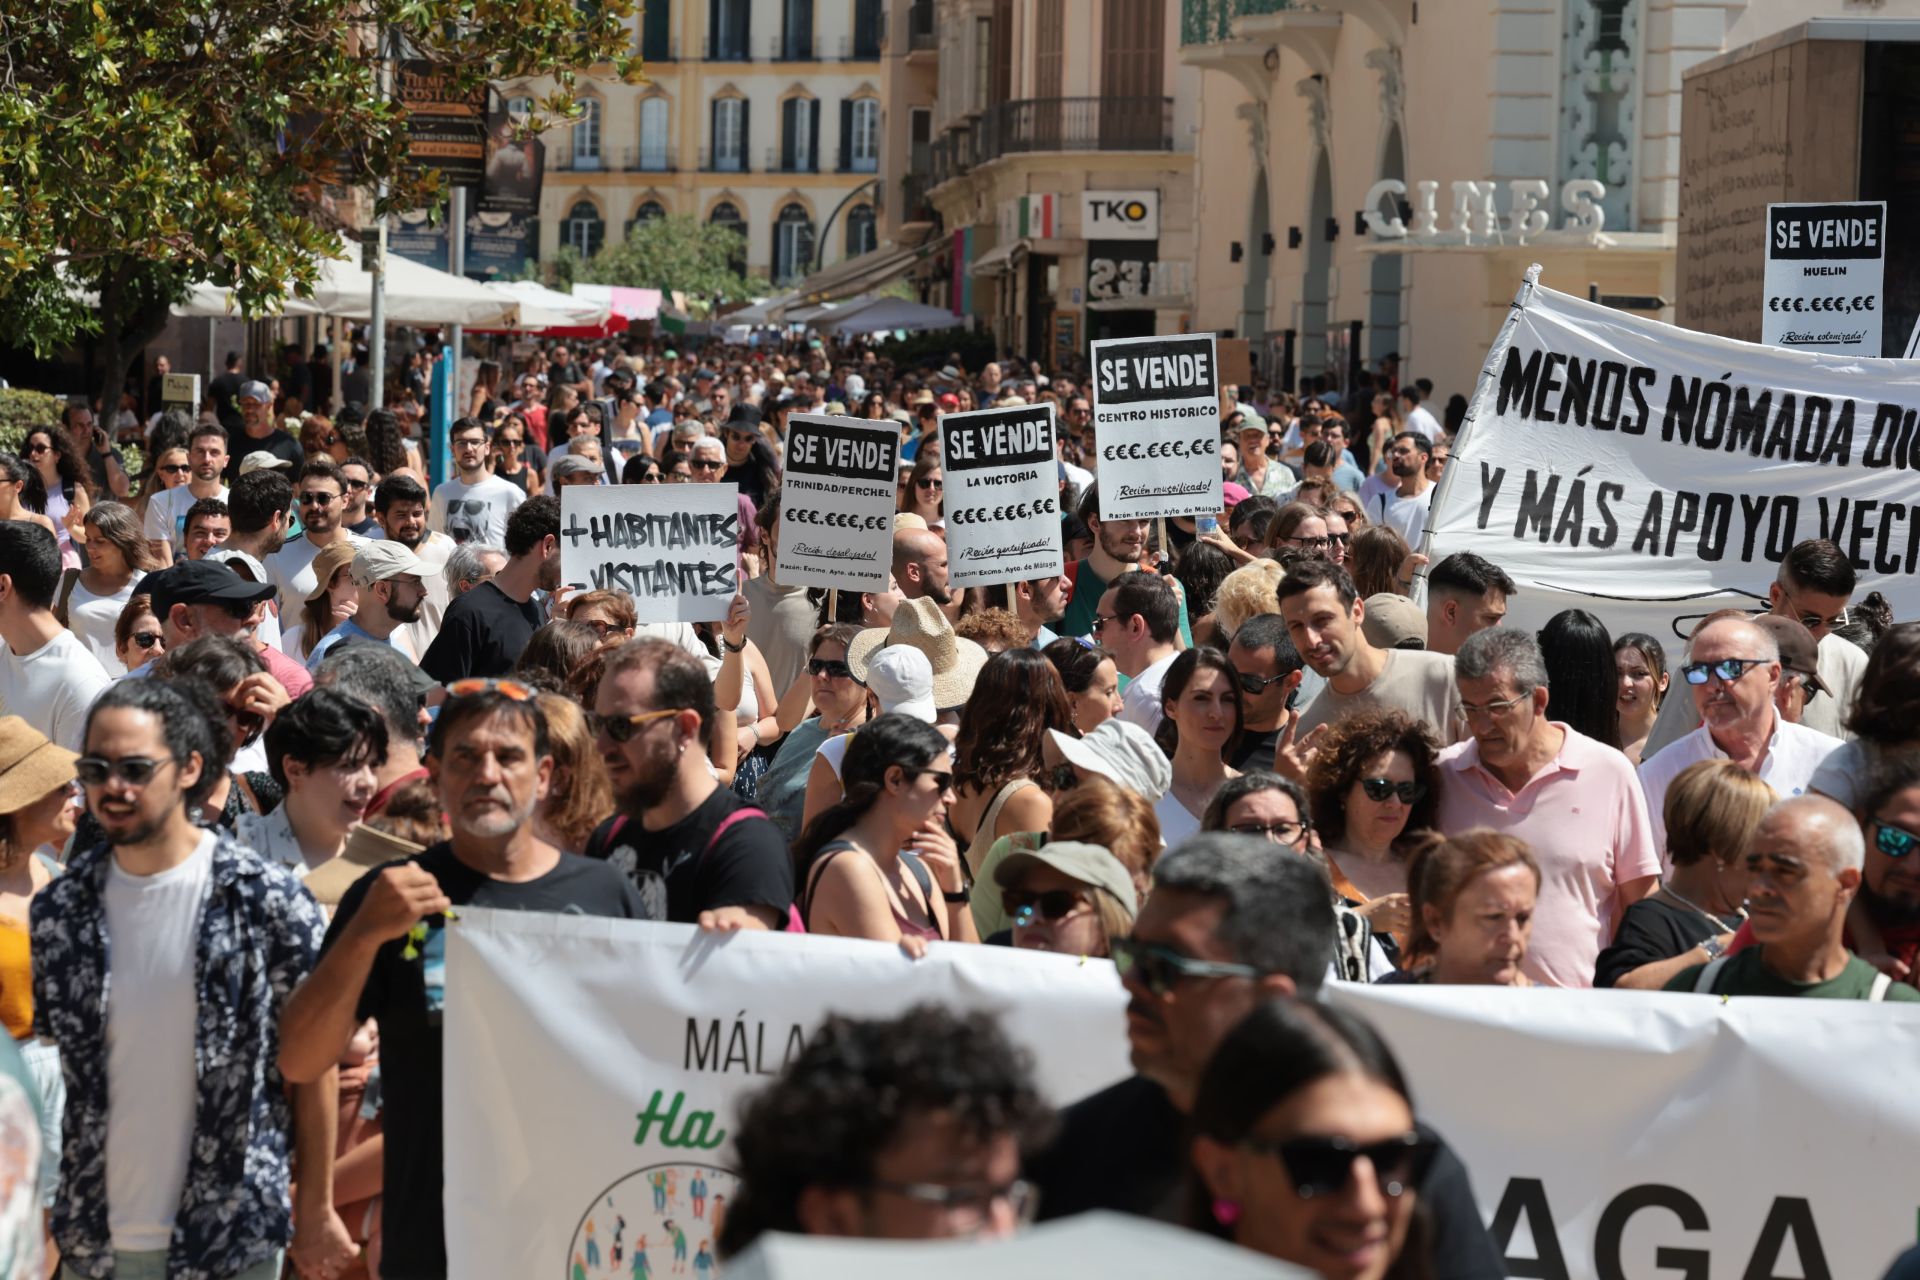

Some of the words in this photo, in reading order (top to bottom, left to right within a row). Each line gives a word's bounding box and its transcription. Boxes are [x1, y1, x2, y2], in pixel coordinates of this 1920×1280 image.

[402, 88, 486, 103] COSTUAS
[1088, 200, 1147, 222] TKO
[1362, 178, 1606, 238] CINES
[1776, 220, 1801, 249] SE
[1807, 218, 1877, 248] VENDE
[1803, 266, 1847, 276] HUELIN
[1769, 295, 1875, 315] €€€.€€€,€€
[1100, 357, 1129, 393] SE
[1133, 353, 1209, 390] VENDE
[1097, 409, 1147, 423] CENTRO
[1150, 405, 1217, 420] HISTORICO
[1496, 345, 1657, 435] MENOS
[1660, 372, 1855, 467] NÓMADA
[792, 432, 819, 464] SE
[822, 436, 892, 472] VENDE
[949, 429, 977, 461] SE
[980, 419, 1050, 458] VENDE
[1103, 438, 1215, 461] €€€.€€€,€€
[786, 479, 892, 498] TRINIDAD/PERCHEL
[966, 477, 981, 488] LA
[983, 469, 1038, 486] VICTORIA
[785, 507, 887, 532] €€€.€€€,€€
[952, 498, 1056, 525] €€€.€€€,€€
[1477, 460, 1505, 530] Y
[1513, 464, 1625, 551] MÁS
[1631, 489, 1800, 564] APOYO
[1023, 563, 1033, 571] de
[684, 1009, 806, 1076] MÁLA
[634, 1089, 727, 1150] Ha
